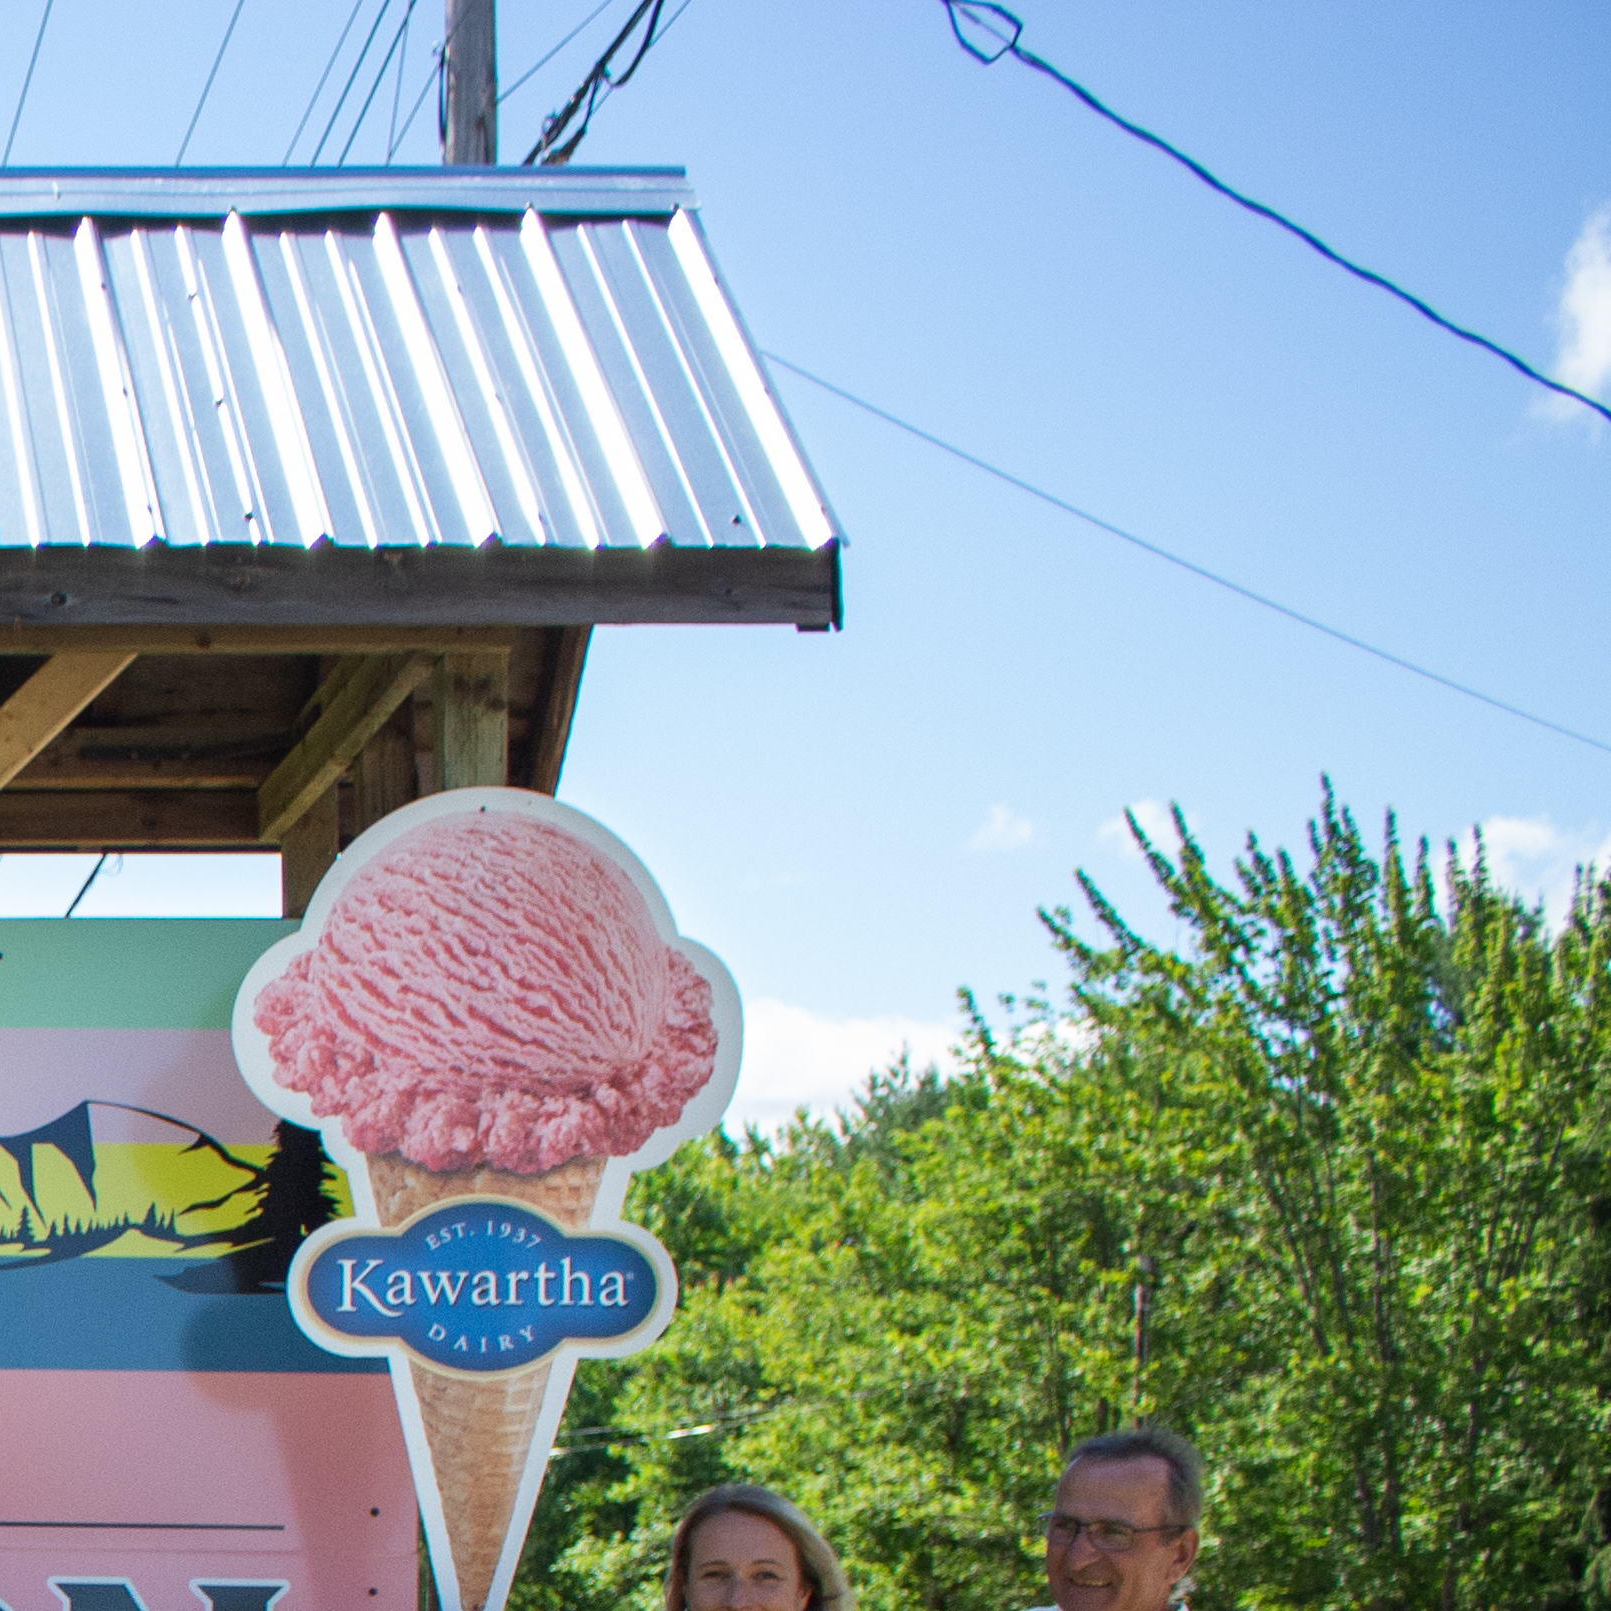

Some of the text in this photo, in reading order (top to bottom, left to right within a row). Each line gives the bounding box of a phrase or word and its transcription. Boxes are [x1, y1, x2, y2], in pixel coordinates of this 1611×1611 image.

[425, 1220, 542, 1251] EST. 1937
[335, 1256, 630, 1317] Kawartha
[427, 1323, 535, 1354] DAIRY
